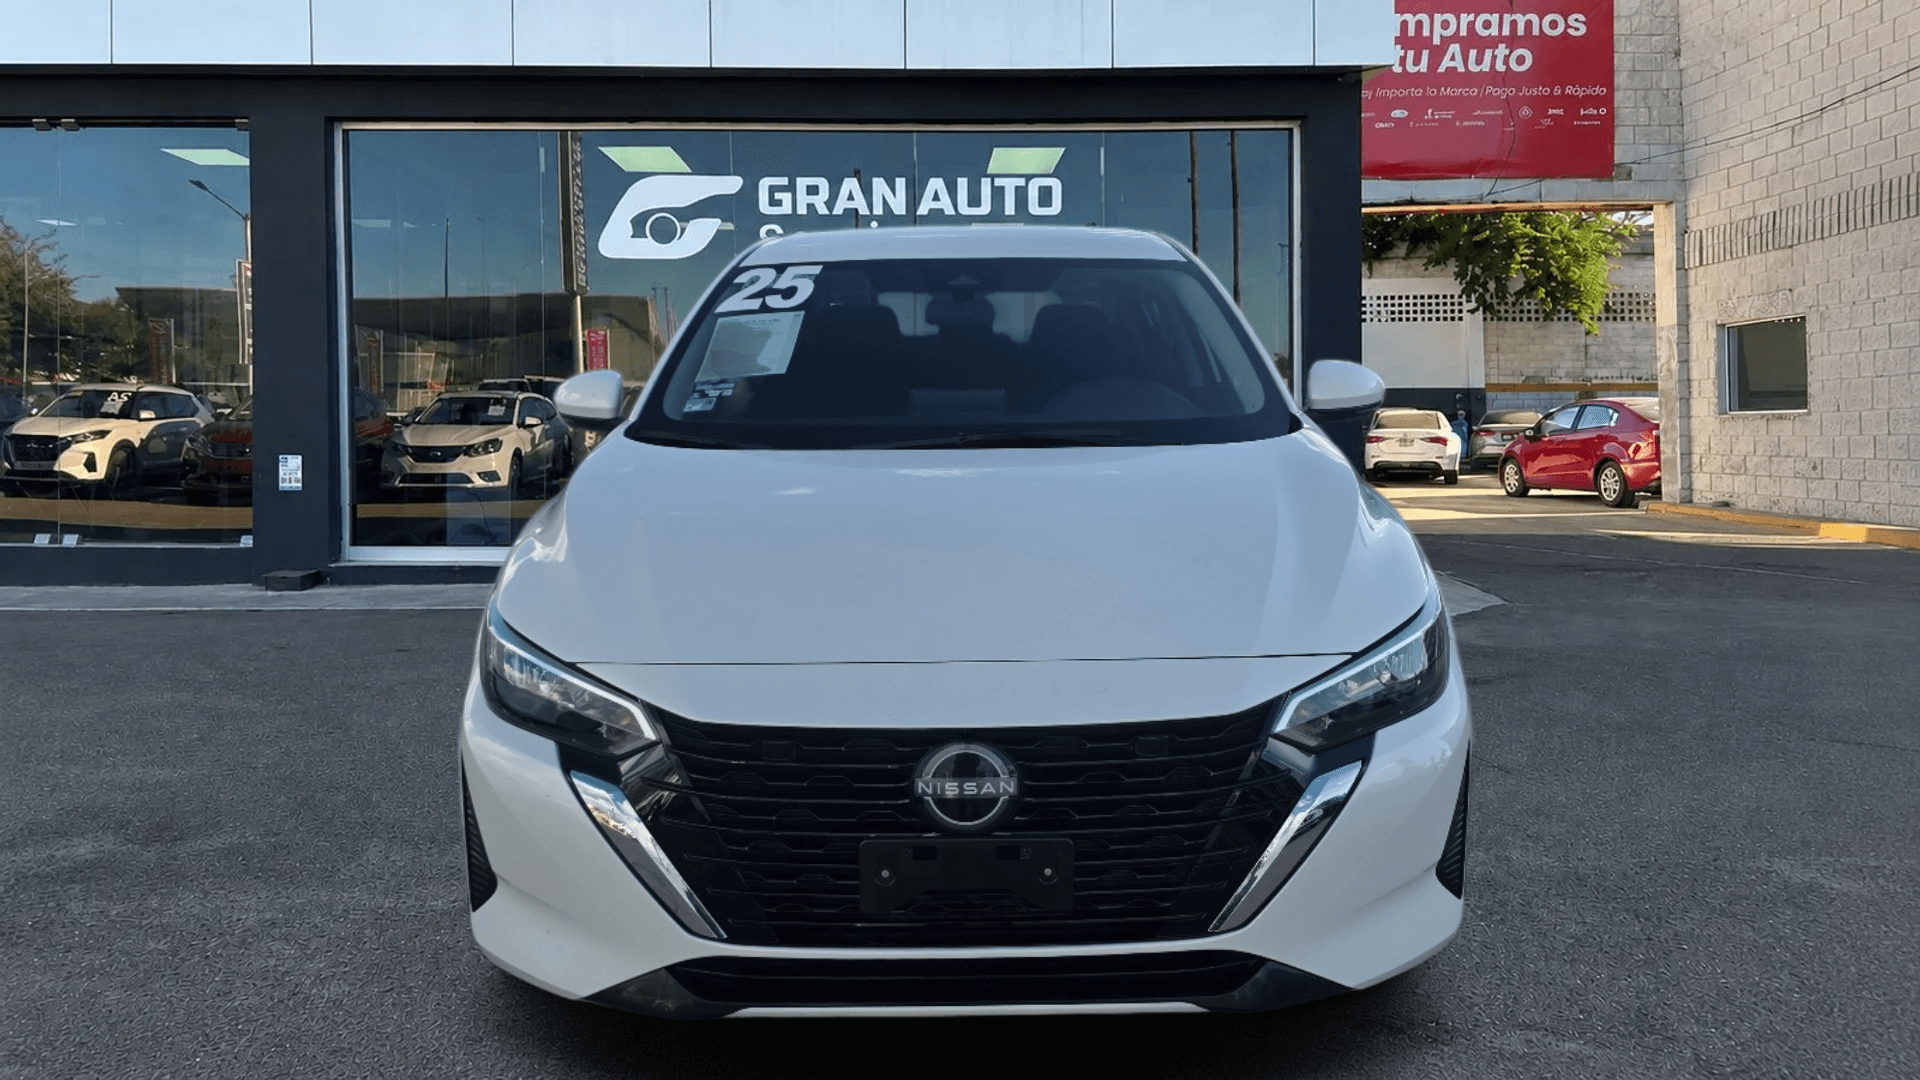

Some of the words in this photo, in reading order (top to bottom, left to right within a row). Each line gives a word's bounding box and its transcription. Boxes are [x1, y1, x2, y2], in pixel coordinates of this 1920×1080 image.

[1392, 44, 1429, 73] tu
[1437, 43, 1533, 73] Auto
[1376, 87, 1423, 100] Importa
[1440, 86, 1478, 97] Marca
[1519, 86, 1551, 97] Justo
[758, 177, 906, 216] GRAN
[916, 177, 1062, 216] AUTO
[714, 264, 824, 314] 25
[917, 780, 1015, 795] NISSAN
